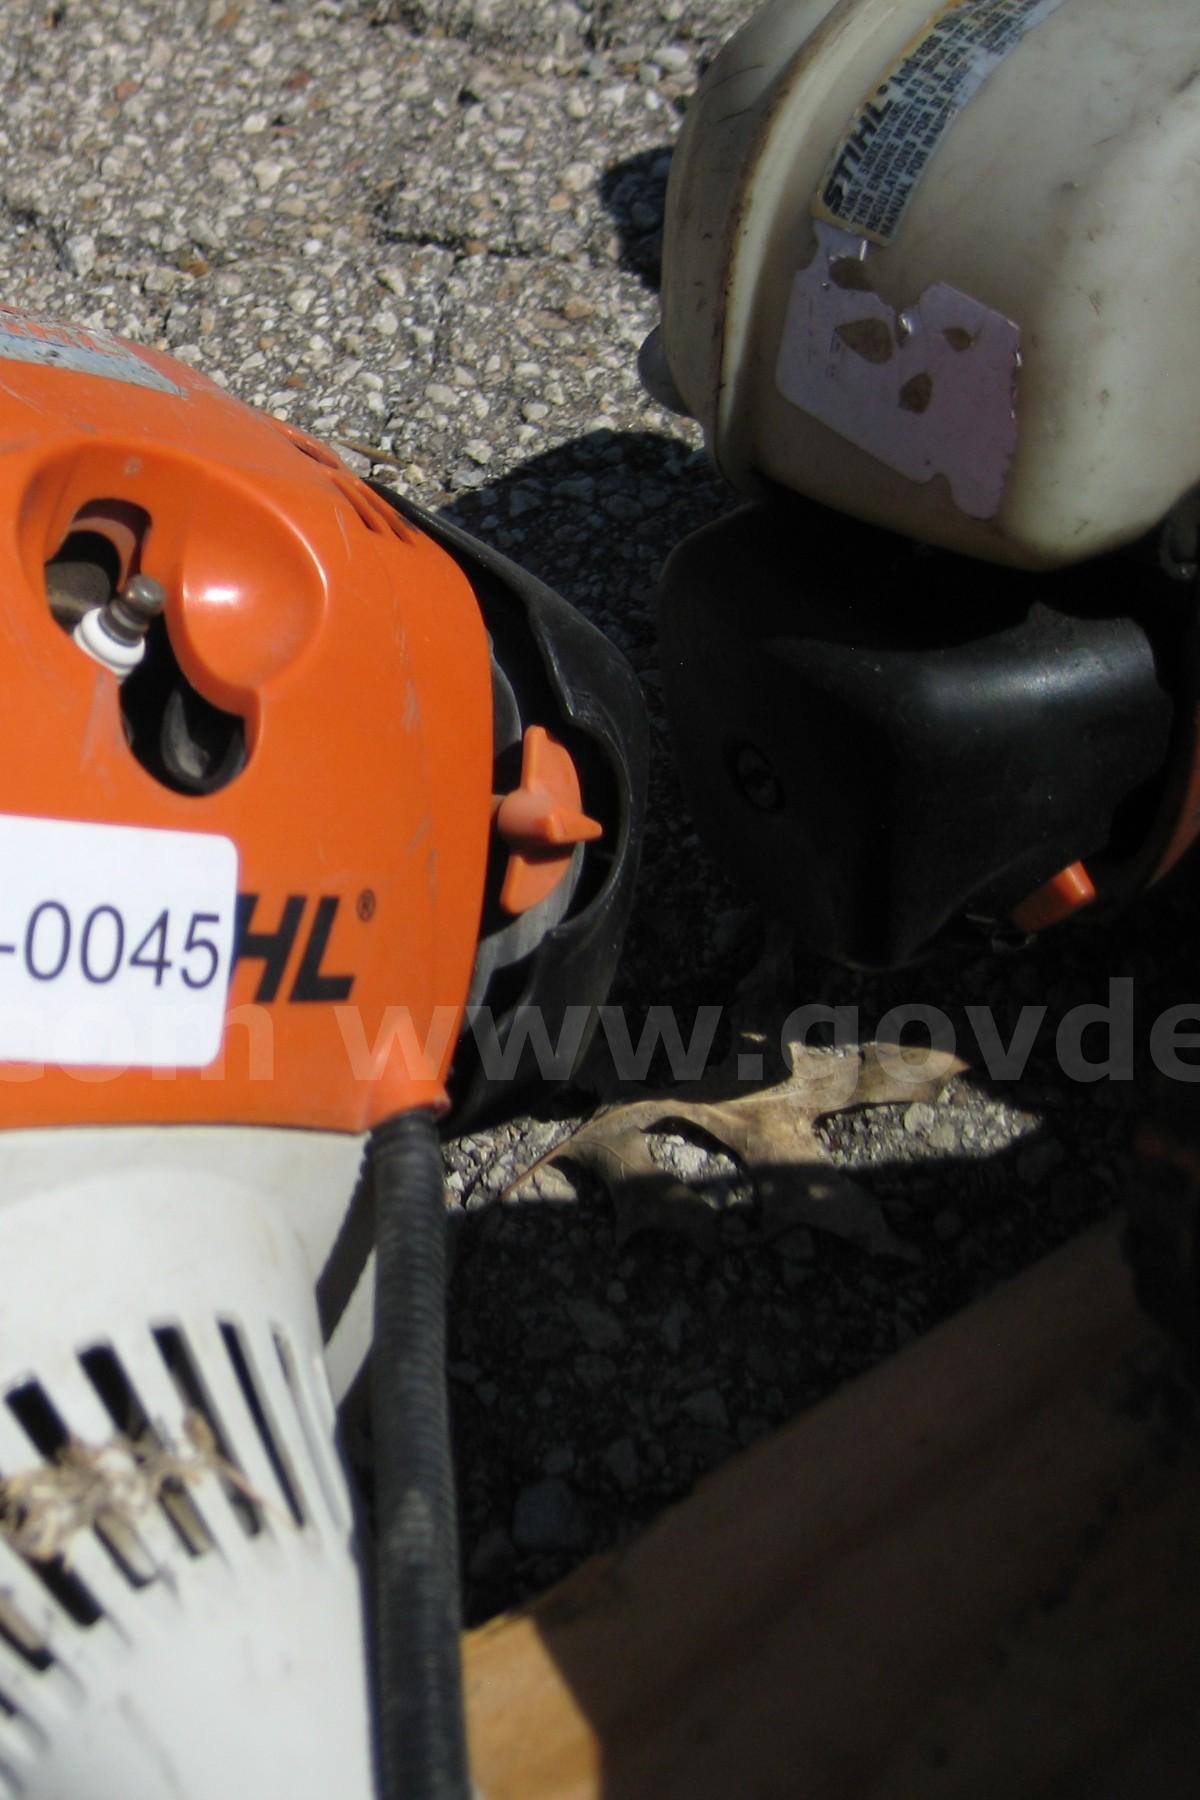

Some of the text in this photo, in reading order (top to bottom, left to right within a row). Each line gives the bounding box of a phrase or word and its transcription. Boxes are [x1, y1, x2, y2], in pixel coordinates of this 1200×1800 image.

[822, 99, 893, 214] STIHL
[888, 34, 942, 87] Andreas
[849, 192, 873, 225] THIS
[866, 141, 898, 191] ENGINE
[892, 95, 927, 140] MEETS
[866, 142, 914, 231] REGULATIONS
[910, 111, 934, 137] FOR
[879, 181, 912, 237] MANUAL
[905, 150, 929, 178] FOR
